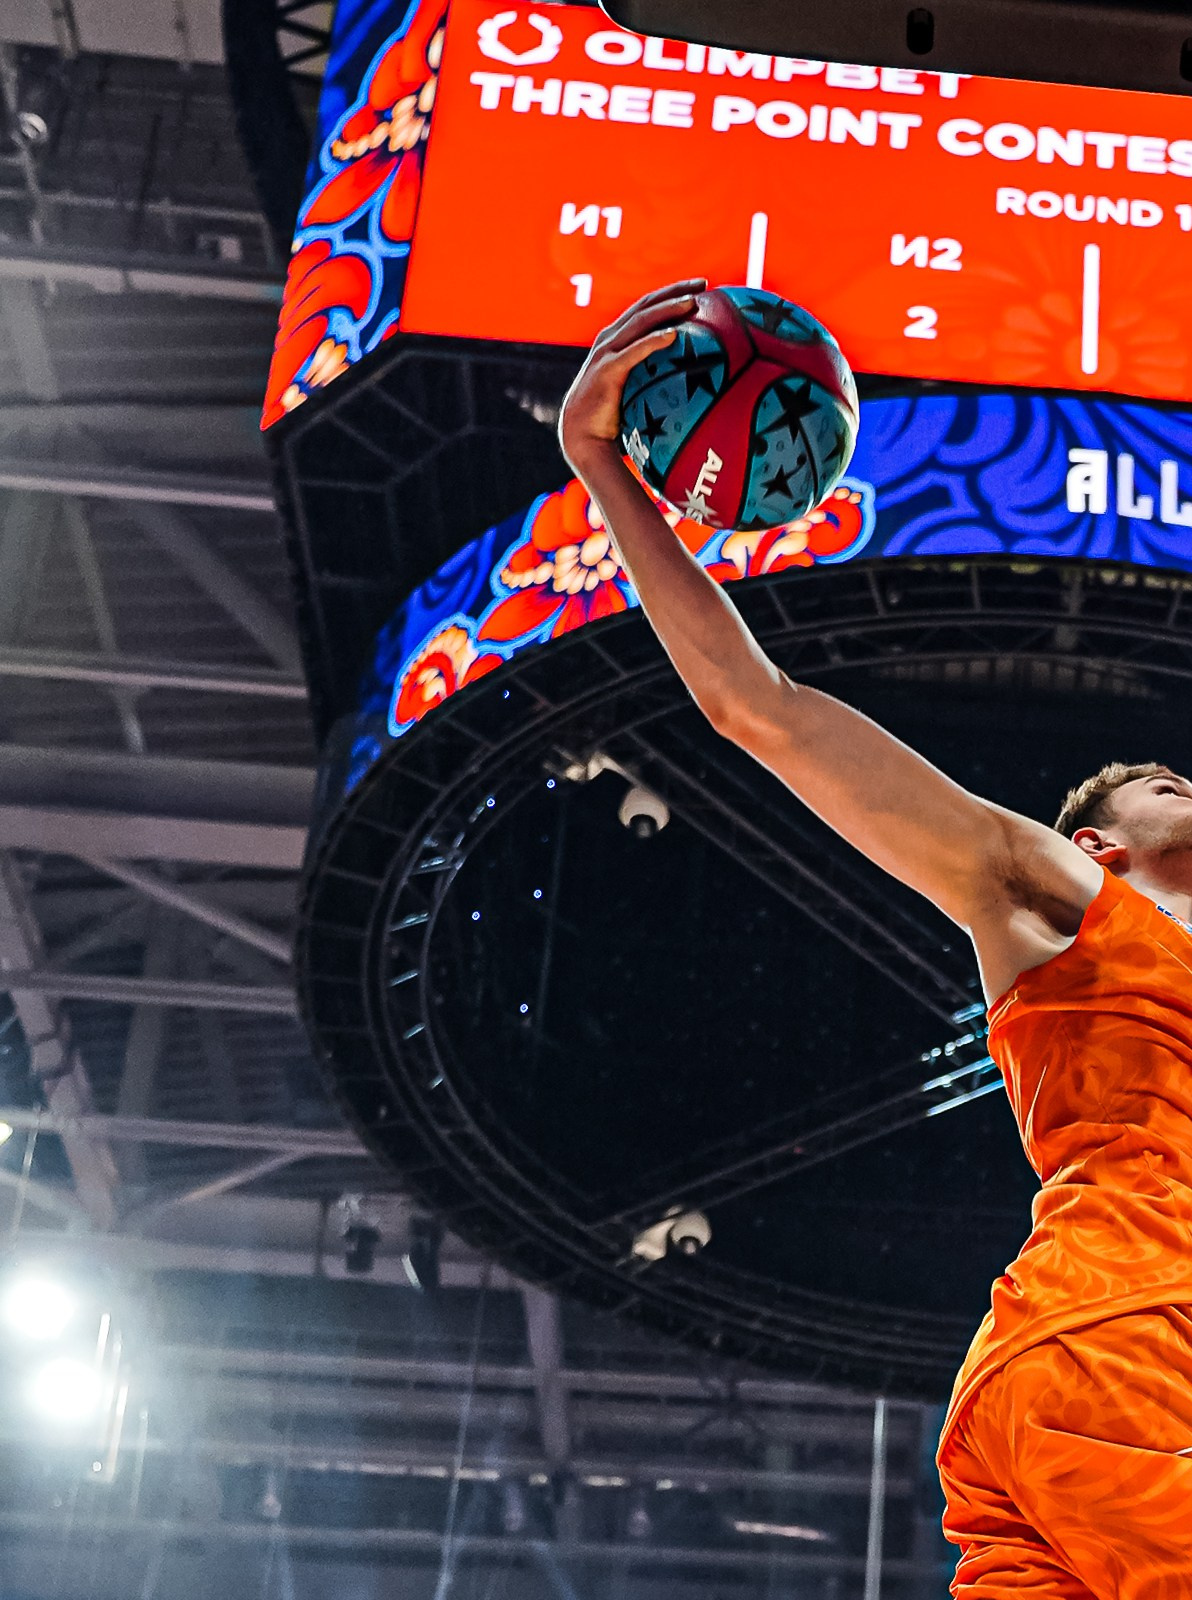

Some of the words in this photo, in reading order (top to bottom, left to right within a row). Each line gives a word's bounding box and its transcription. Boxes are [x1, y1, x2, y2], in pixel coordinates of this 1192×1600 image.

[585, 31, 973, 99] OLIMPBET
[469, 72, 696, 128] THREE
[711, 95, 922, 150] POINT
[995, 187, 1163, 227] ROUND
[1175, 204, 1192, 232] 1
[570, 273, 593, 307] 1
[903, 305, 938, 340] 2
